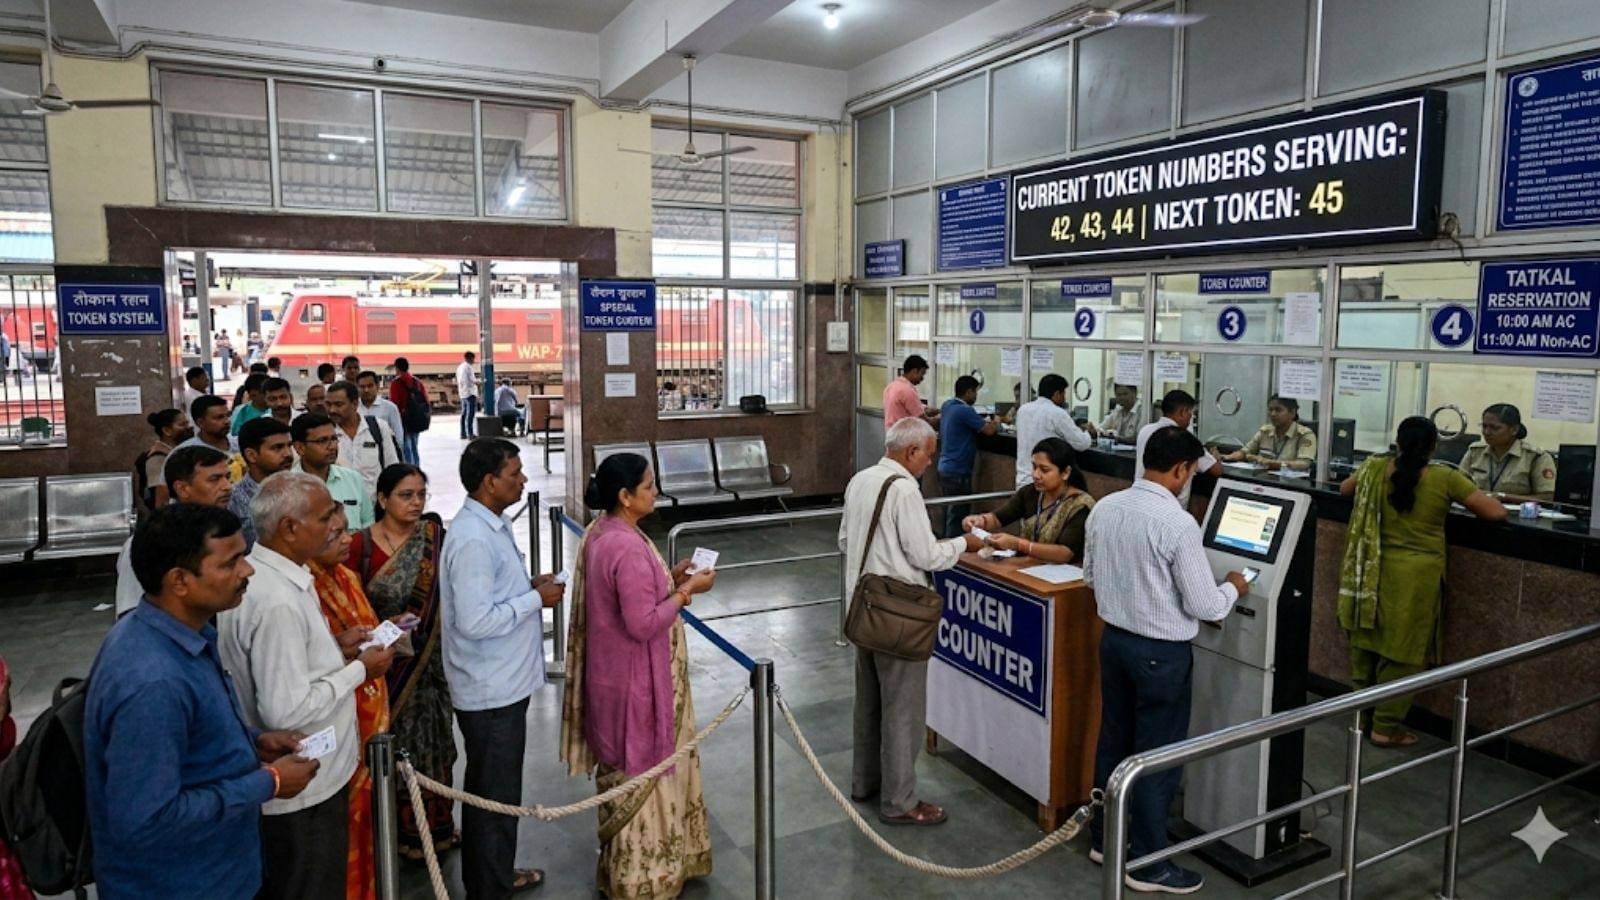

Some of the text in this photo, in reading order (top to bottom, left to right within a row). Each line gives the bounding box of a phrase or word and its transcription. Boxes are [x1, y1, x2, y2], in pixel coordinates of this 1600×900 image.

[1018, 121, 1407, 211] CURRENT TOKEN NUMBERS SERVING:
[1051, 215, 1075, 243] 42,
[1080, 211, 1106, 240] 43,
[1111, 208, 1134, 236] 44
[1154, 197, 1209, 231] NEXT
[1214, 187, 1301, 225] TOKEN:
[1308, 180, 1344, 215] 45
[1506, 267, 1576, 287] TATKAL
[1487, 291, 1591, 308] RESERVATION
[67, 312, 107, 325] TOKEN
[973, 313, 980, 331] 1
[1079, 312, 1090, 333] 2
[1224, 311, 1239, 336] 3
[1440, 311, 1463, 341] 4
[1496, 314, 1576, 328] 10:00 AM AC
[1482, 333, 1591, 348] 11:00 AM Non-AC
[517, 344, 563, 359] WAP-7
[944, 578, 1013, 637] TOKEN
[938, 617, 1034, 693] COUNTER
